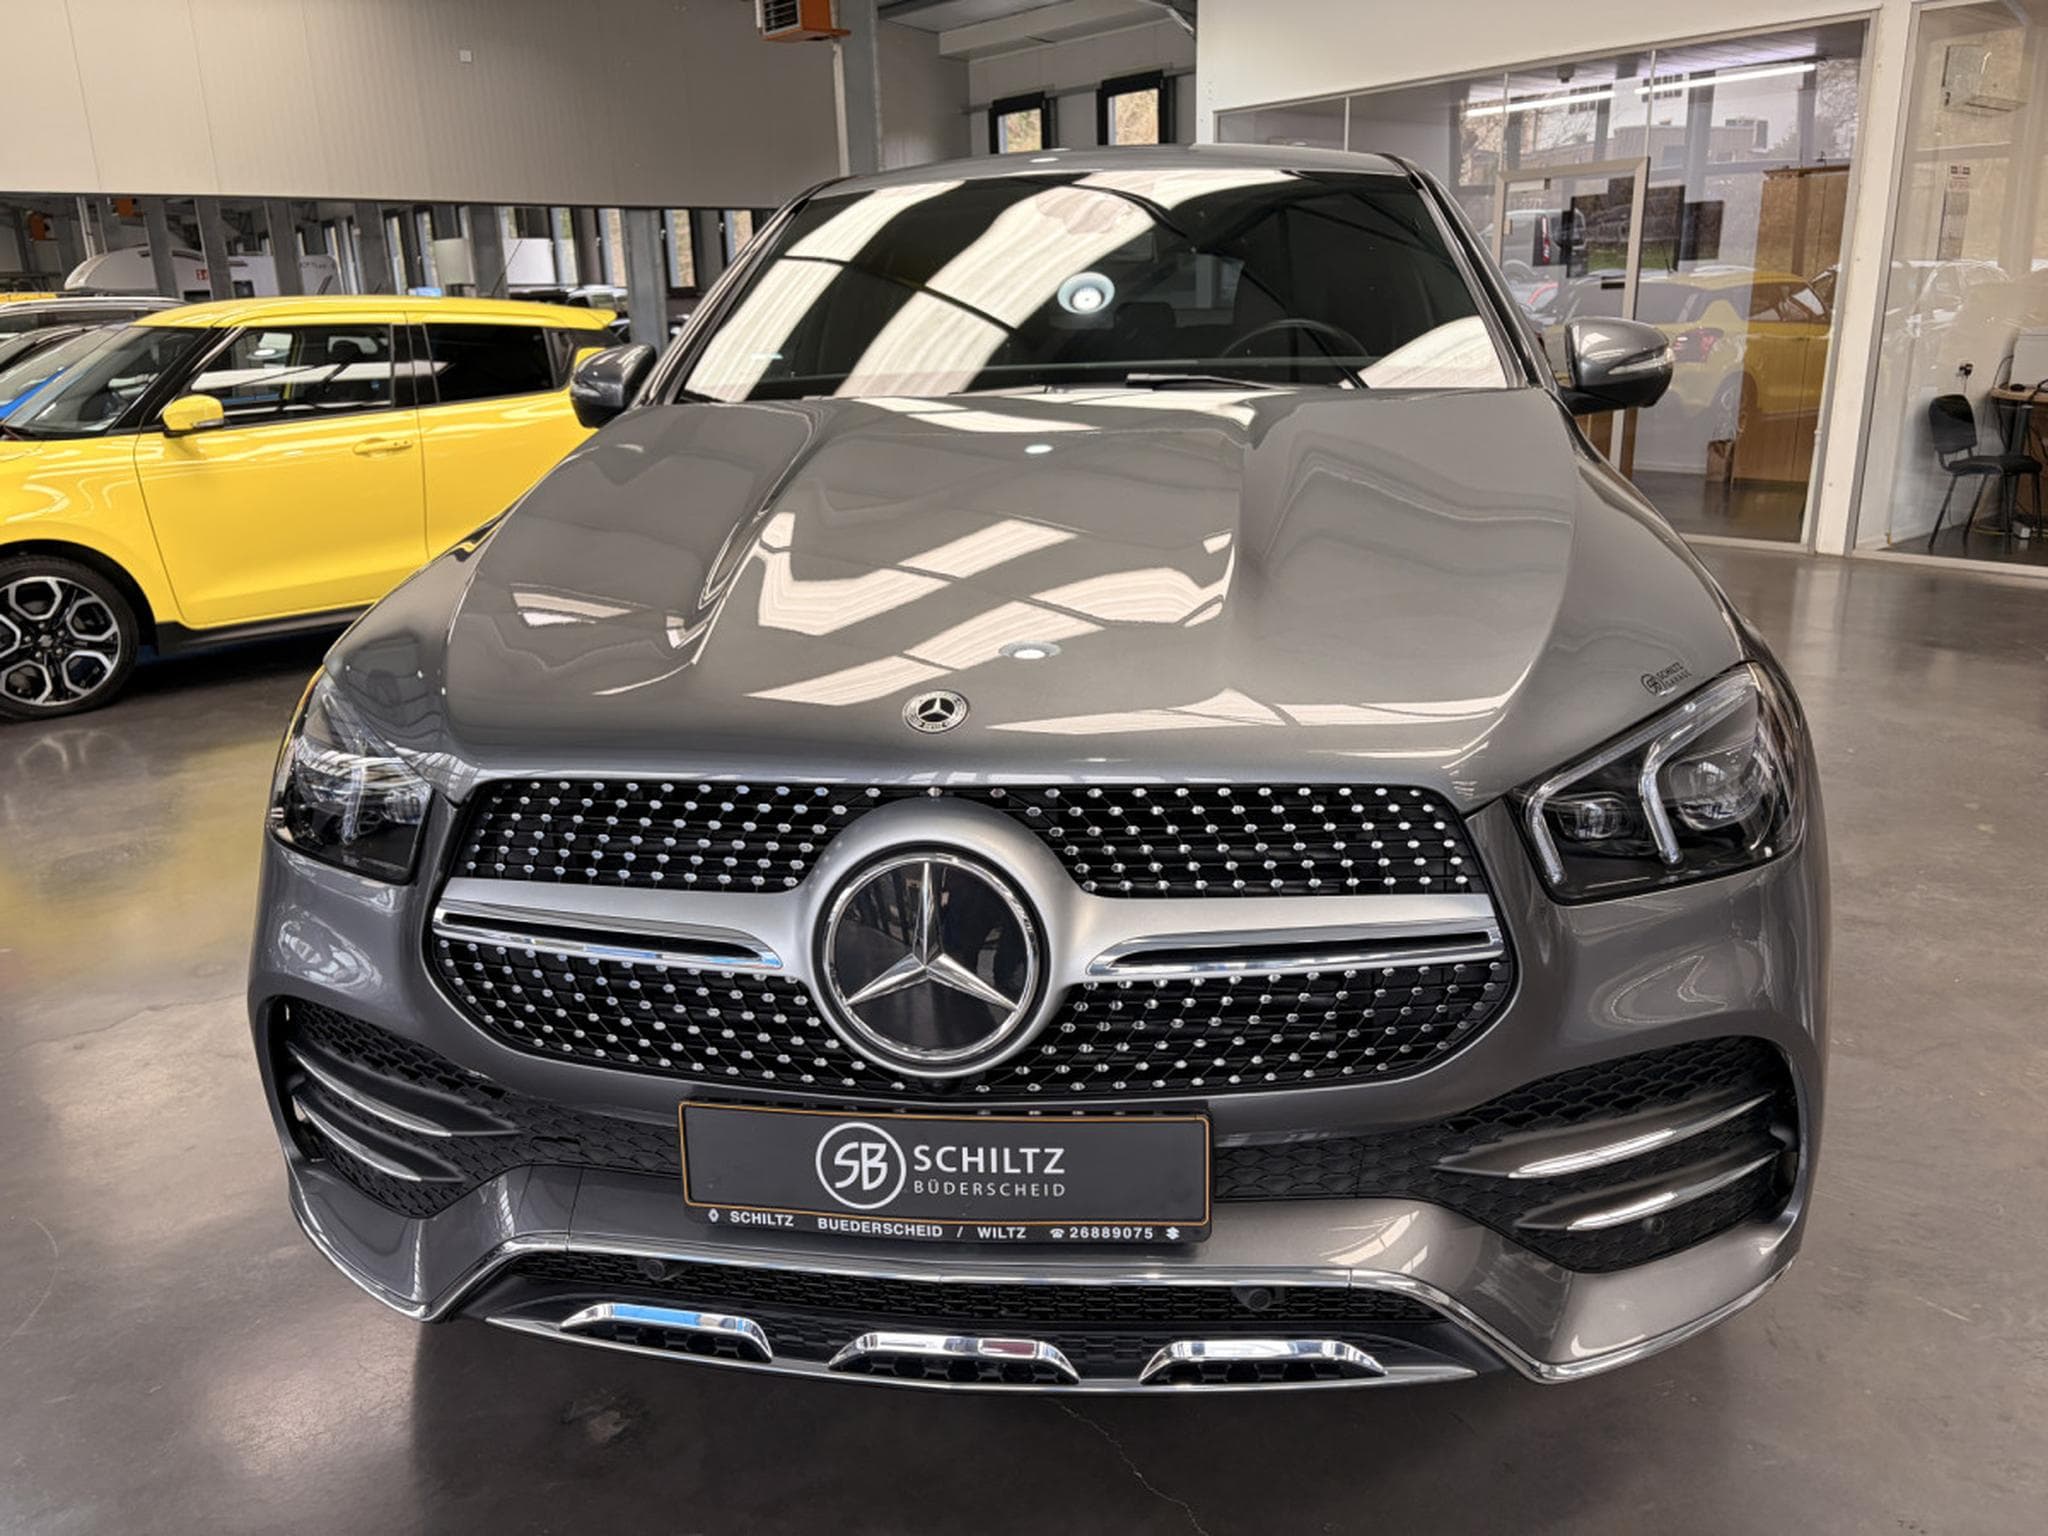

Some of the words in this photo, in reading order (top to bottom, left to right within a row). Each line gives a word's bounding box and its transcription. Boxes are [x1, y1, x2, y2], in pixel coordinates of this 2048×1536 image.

[834, 1141, 888, 1190] SB
[913, 1145, 1065, 1174] SCHILTZ
[914, 1179, 1065, 1197] BÜDERSCHEID
[730, 1211, 794, 1227] SCHILTZ
[818, 1218, 943, 1237] BUEDERSCHEID
[977, 1227, 1026, 1239] WILTZ
[1069, 1227, 1153, 1239] 26889075
